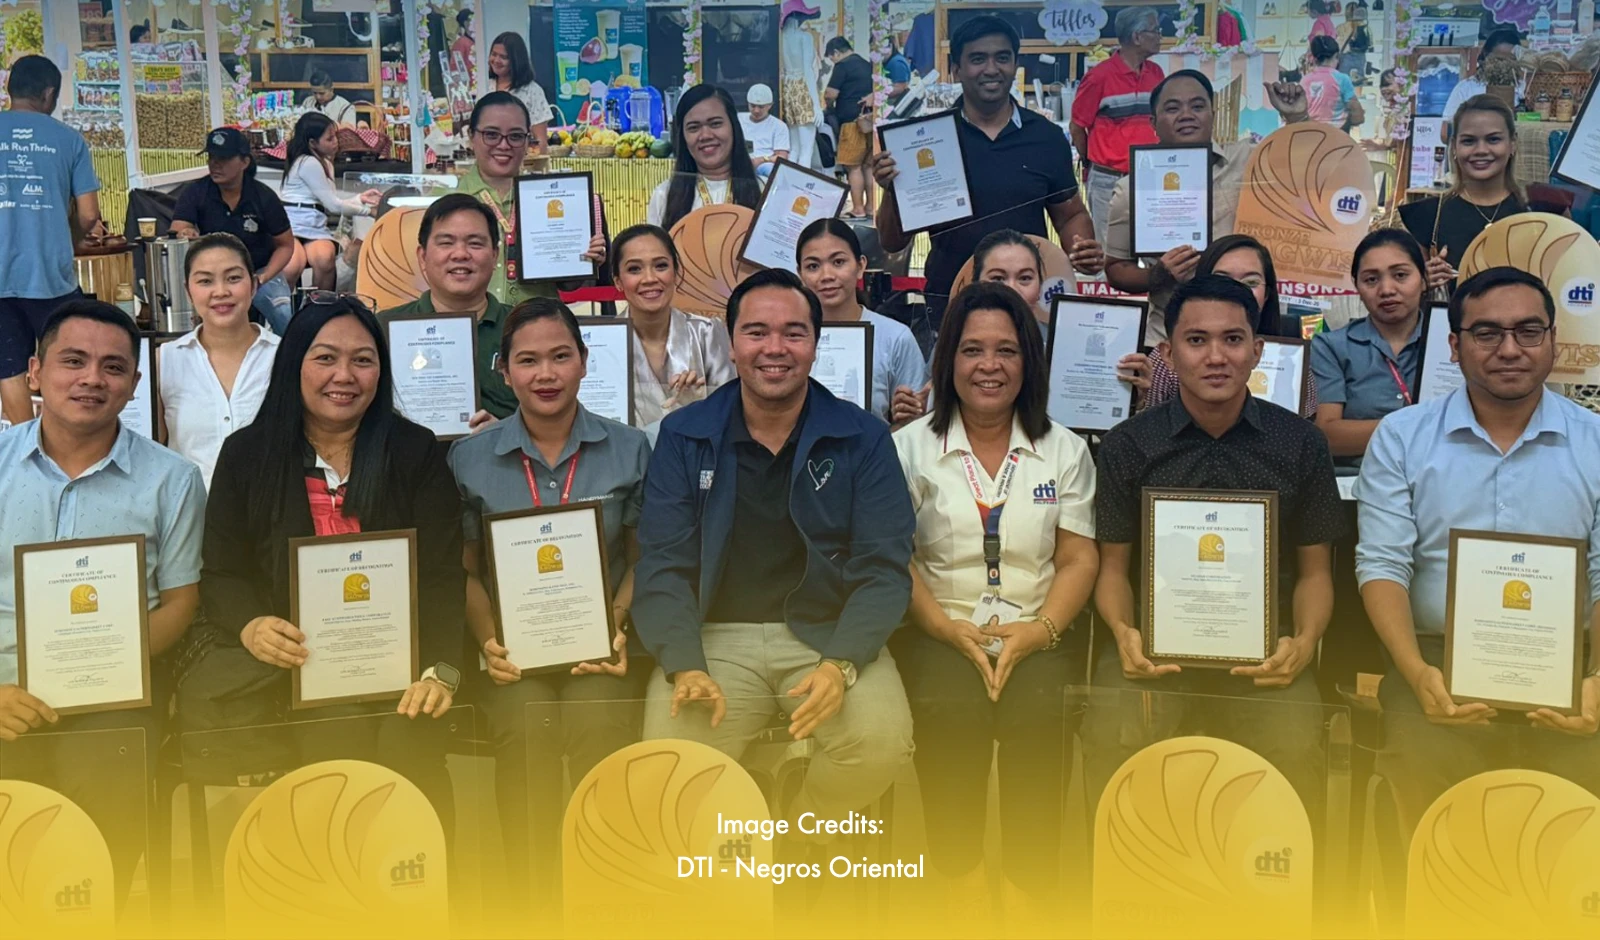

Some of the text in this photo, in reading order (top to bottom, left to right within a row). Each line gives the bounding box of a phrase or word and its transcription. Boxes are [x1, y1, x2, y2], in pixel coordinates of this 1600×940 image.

[30, 143, 56, 154] Thrive
[1337, 194, 1362, 211] dti
[1240, 222, 1311, 245] BRONZE
[1082, 283, 1130, 295] MAL
[1568, 283, 1595, 301] dti
[1033, 479, 1056, 498] dti
[718, 833, 753, 859] dti
[390, 852, 426, 882] dti
[1255, 847, 1292, 873] dti
[55, 878, 92, 907] dti
